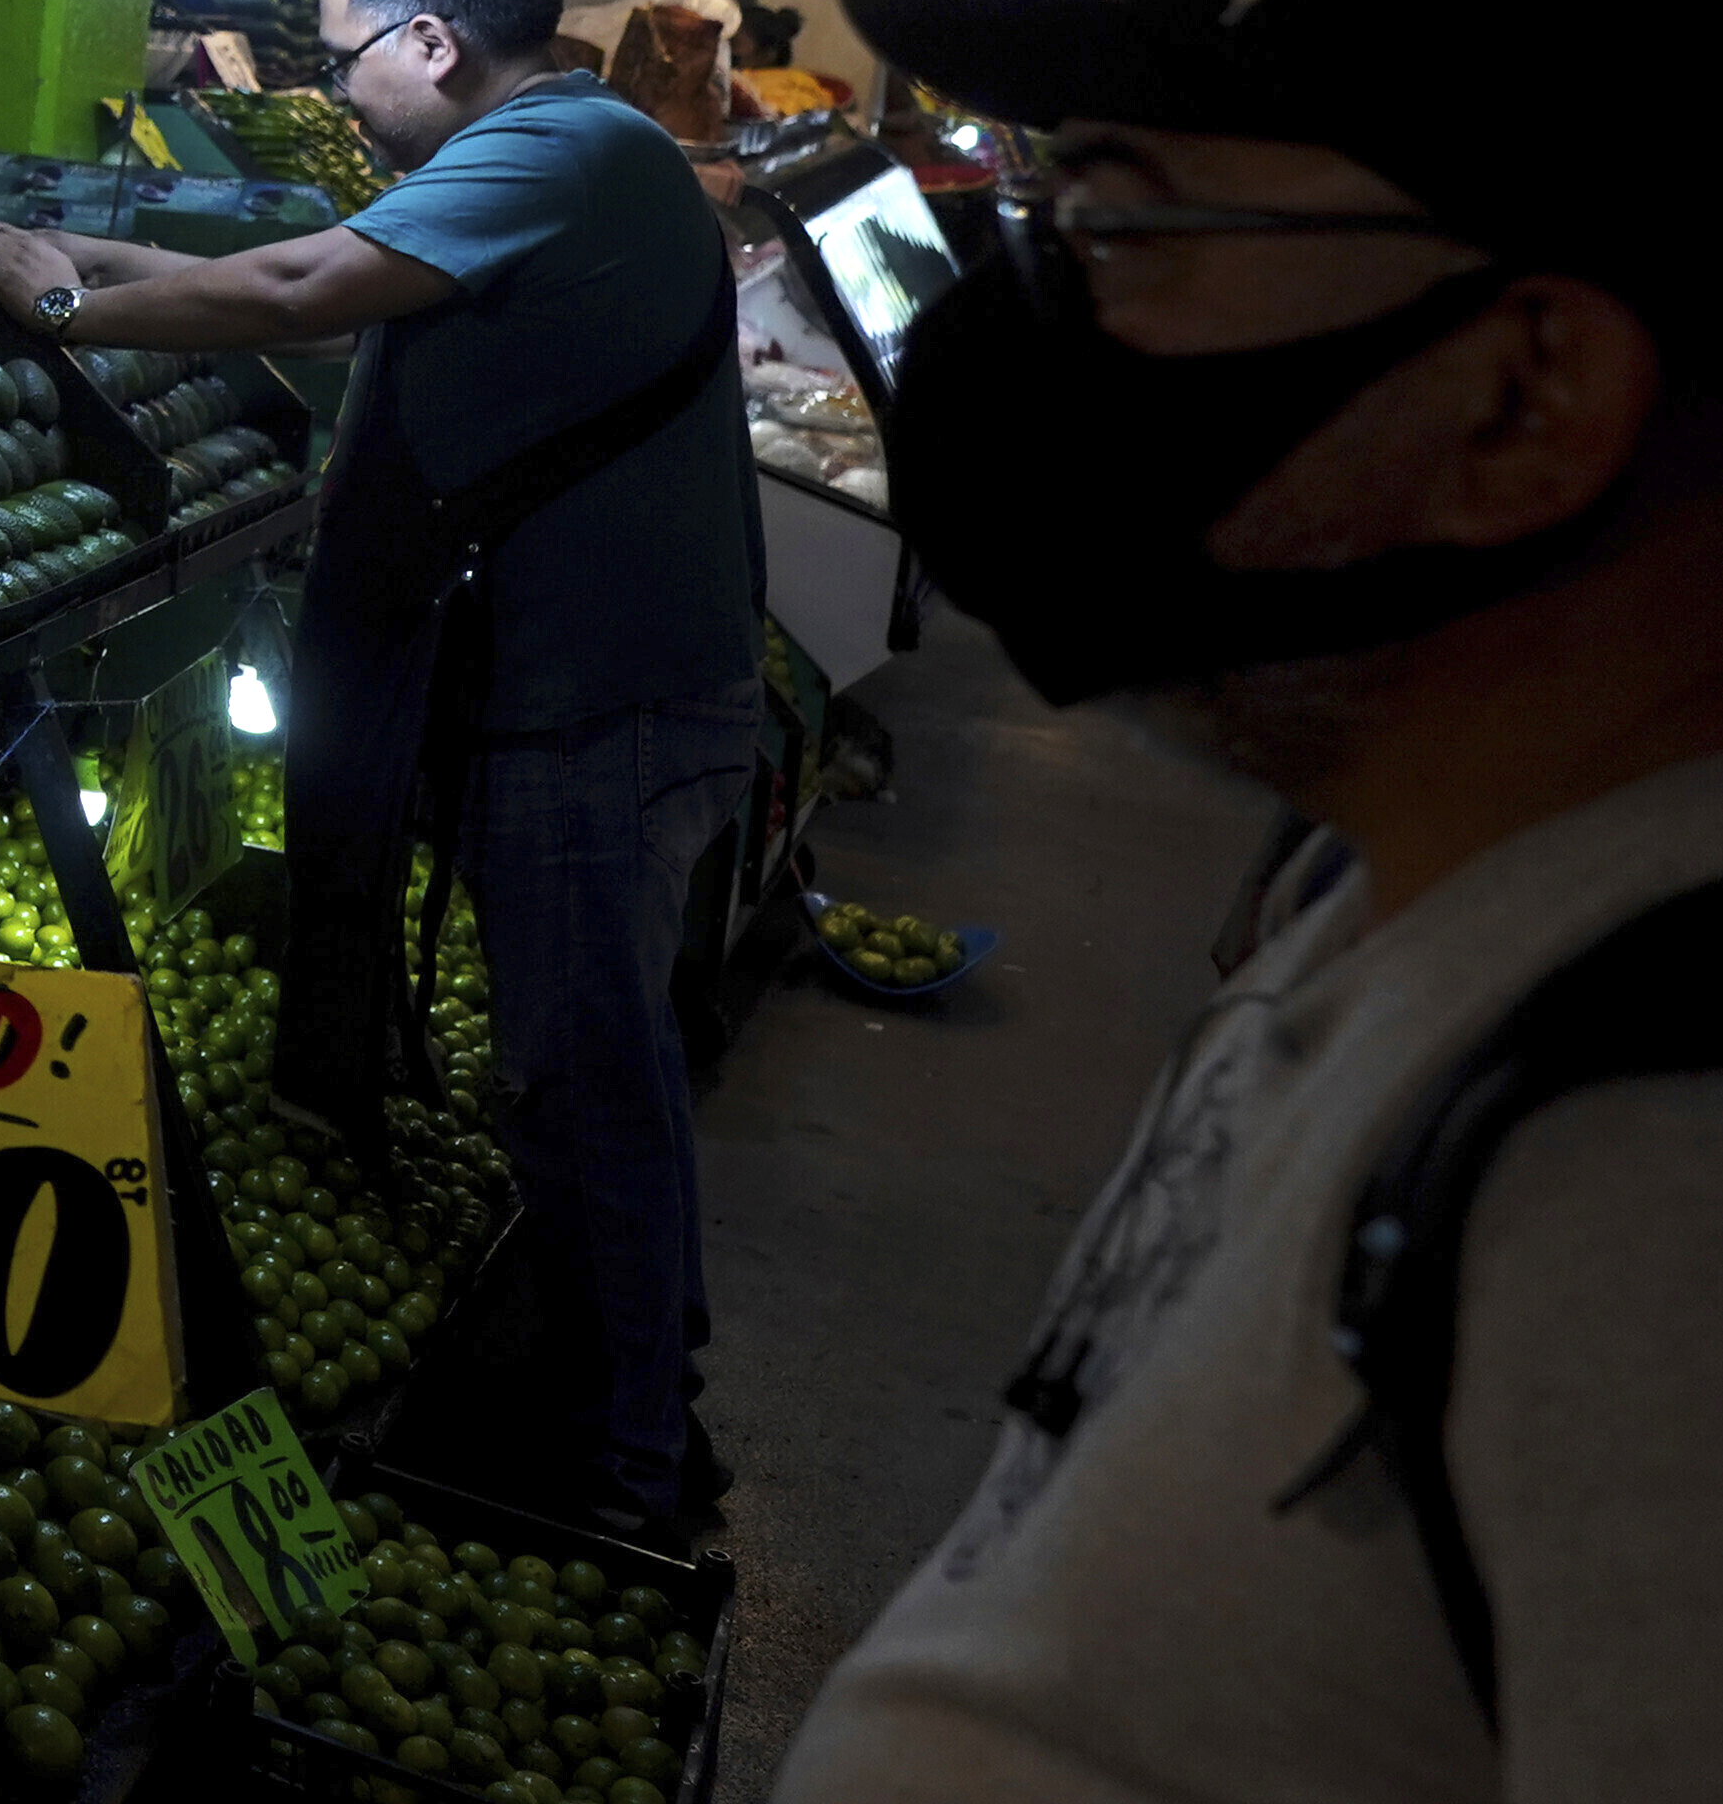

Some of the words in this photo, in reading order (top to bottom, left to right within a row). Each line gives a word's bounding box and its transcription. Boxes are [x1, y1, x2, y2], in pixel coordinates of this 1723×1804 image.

[144, 1403, 273, 1511] CALIDAD
[190, 1480, 326, 1632] 18
[267, 1469, 312, 1521] 00
[303, 1541, 360, 1580] KILO
